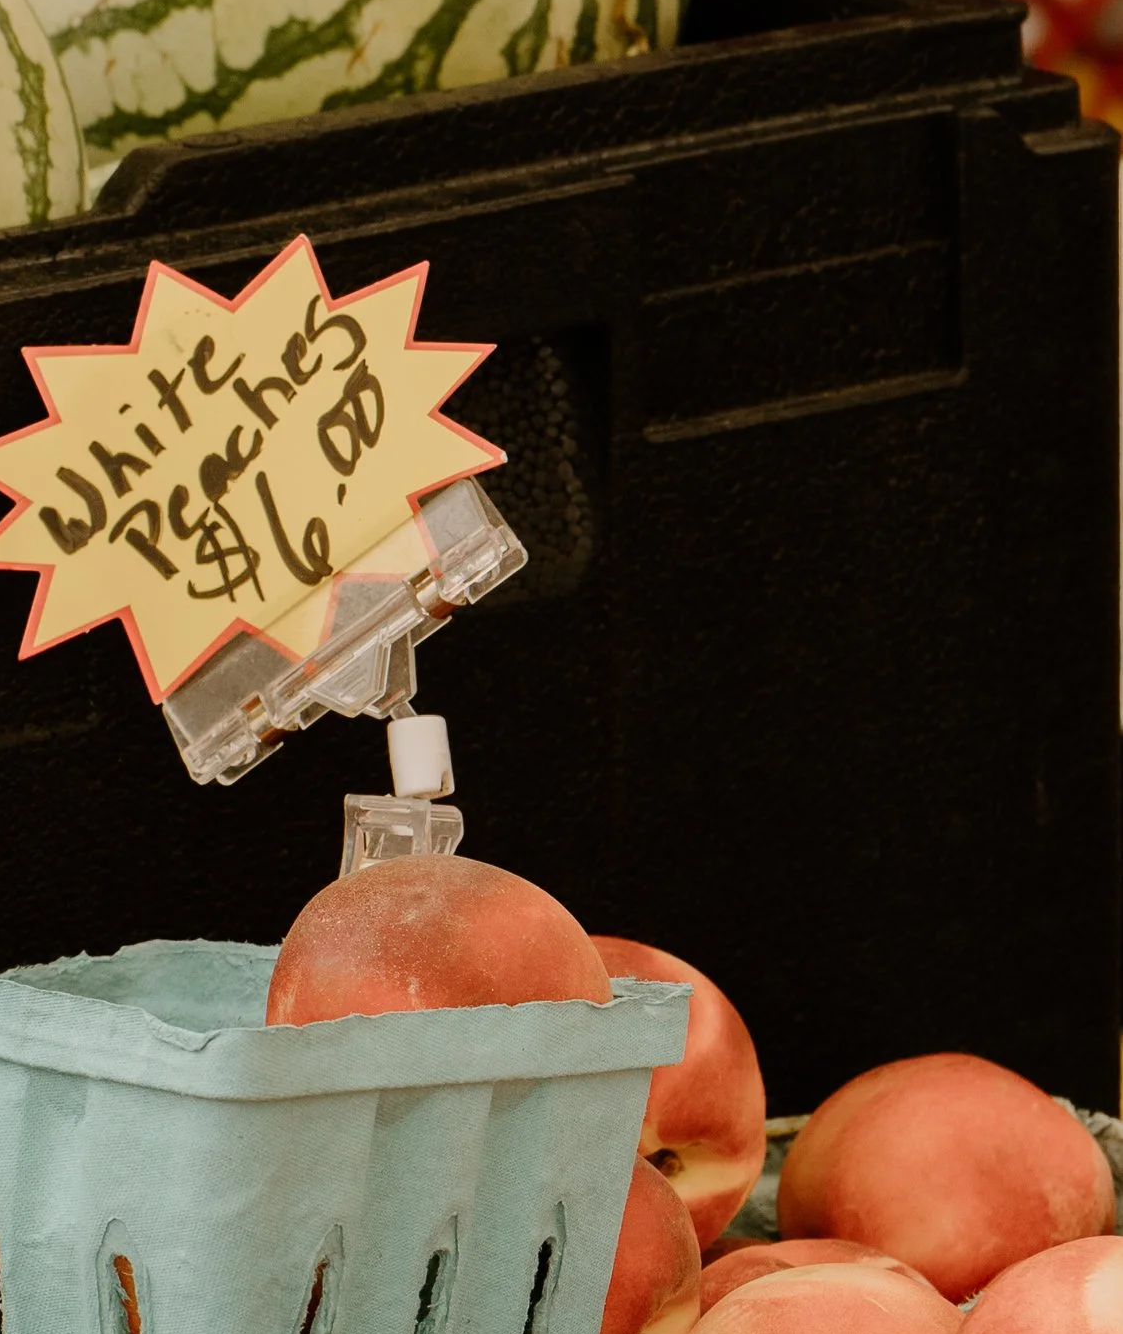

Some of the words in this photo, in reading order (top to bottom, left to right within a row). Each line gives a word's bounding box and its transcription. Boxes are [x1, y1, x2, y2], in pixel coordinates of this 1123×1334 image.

[39, 335, 246, 555] White
[109, 294, 368, 581] Peaches
[187, 360, 385, 602] $6.00
